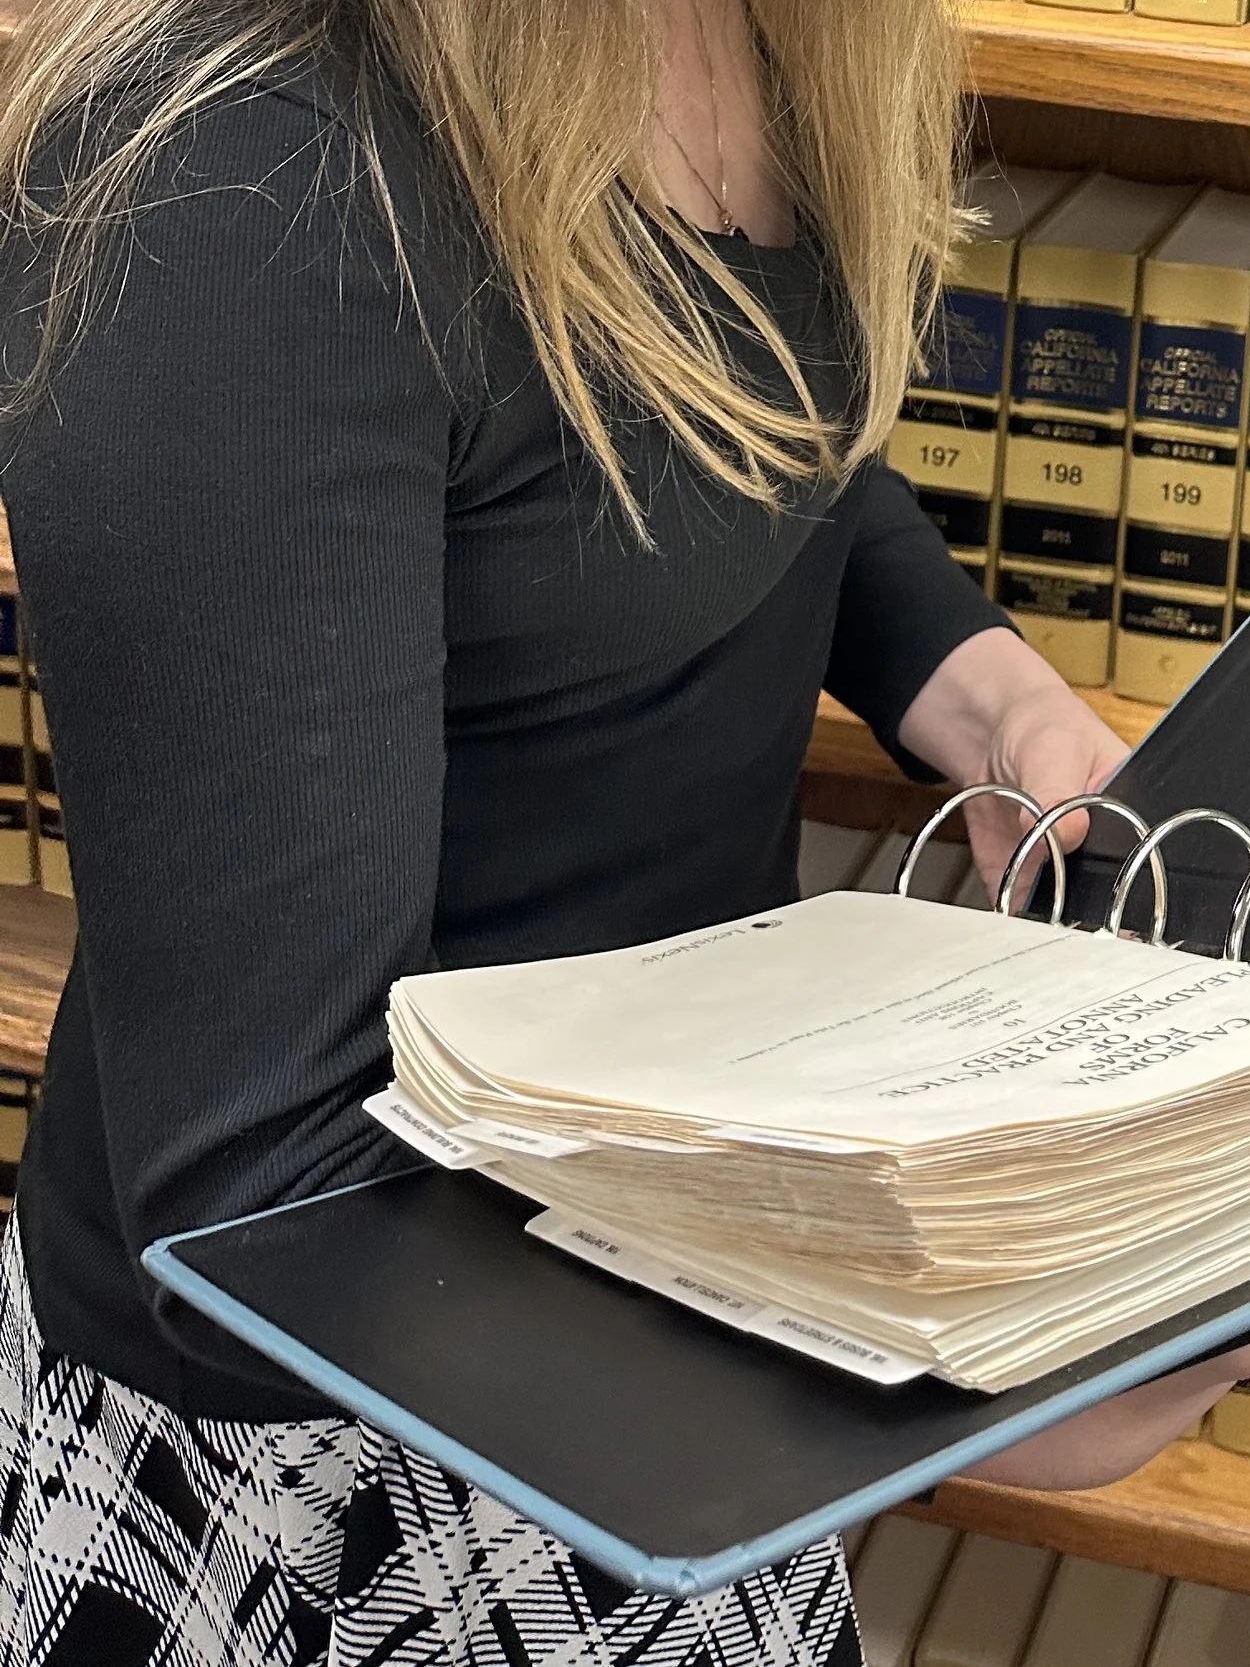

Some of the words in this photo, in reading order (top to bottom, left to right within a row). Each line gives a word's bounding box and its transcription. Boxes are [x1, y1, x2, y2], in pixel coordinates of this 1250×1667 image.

[919, 445, 960, 468] 197
[1042, 462, 1083, 486] 198
[1160, 482, 1202, 506] 199
[642, 929, 746, 965] LexisNexis
[961, 993, 1144, 1069] ANNOTATED
[1045, 1021, 1110, 1053] AND
[1083, 1031, 1131, 1054] OF
[1077, 1025, 1191, 1072] FORMS
[877, 1052, 1047, 1099] PRACTICE
